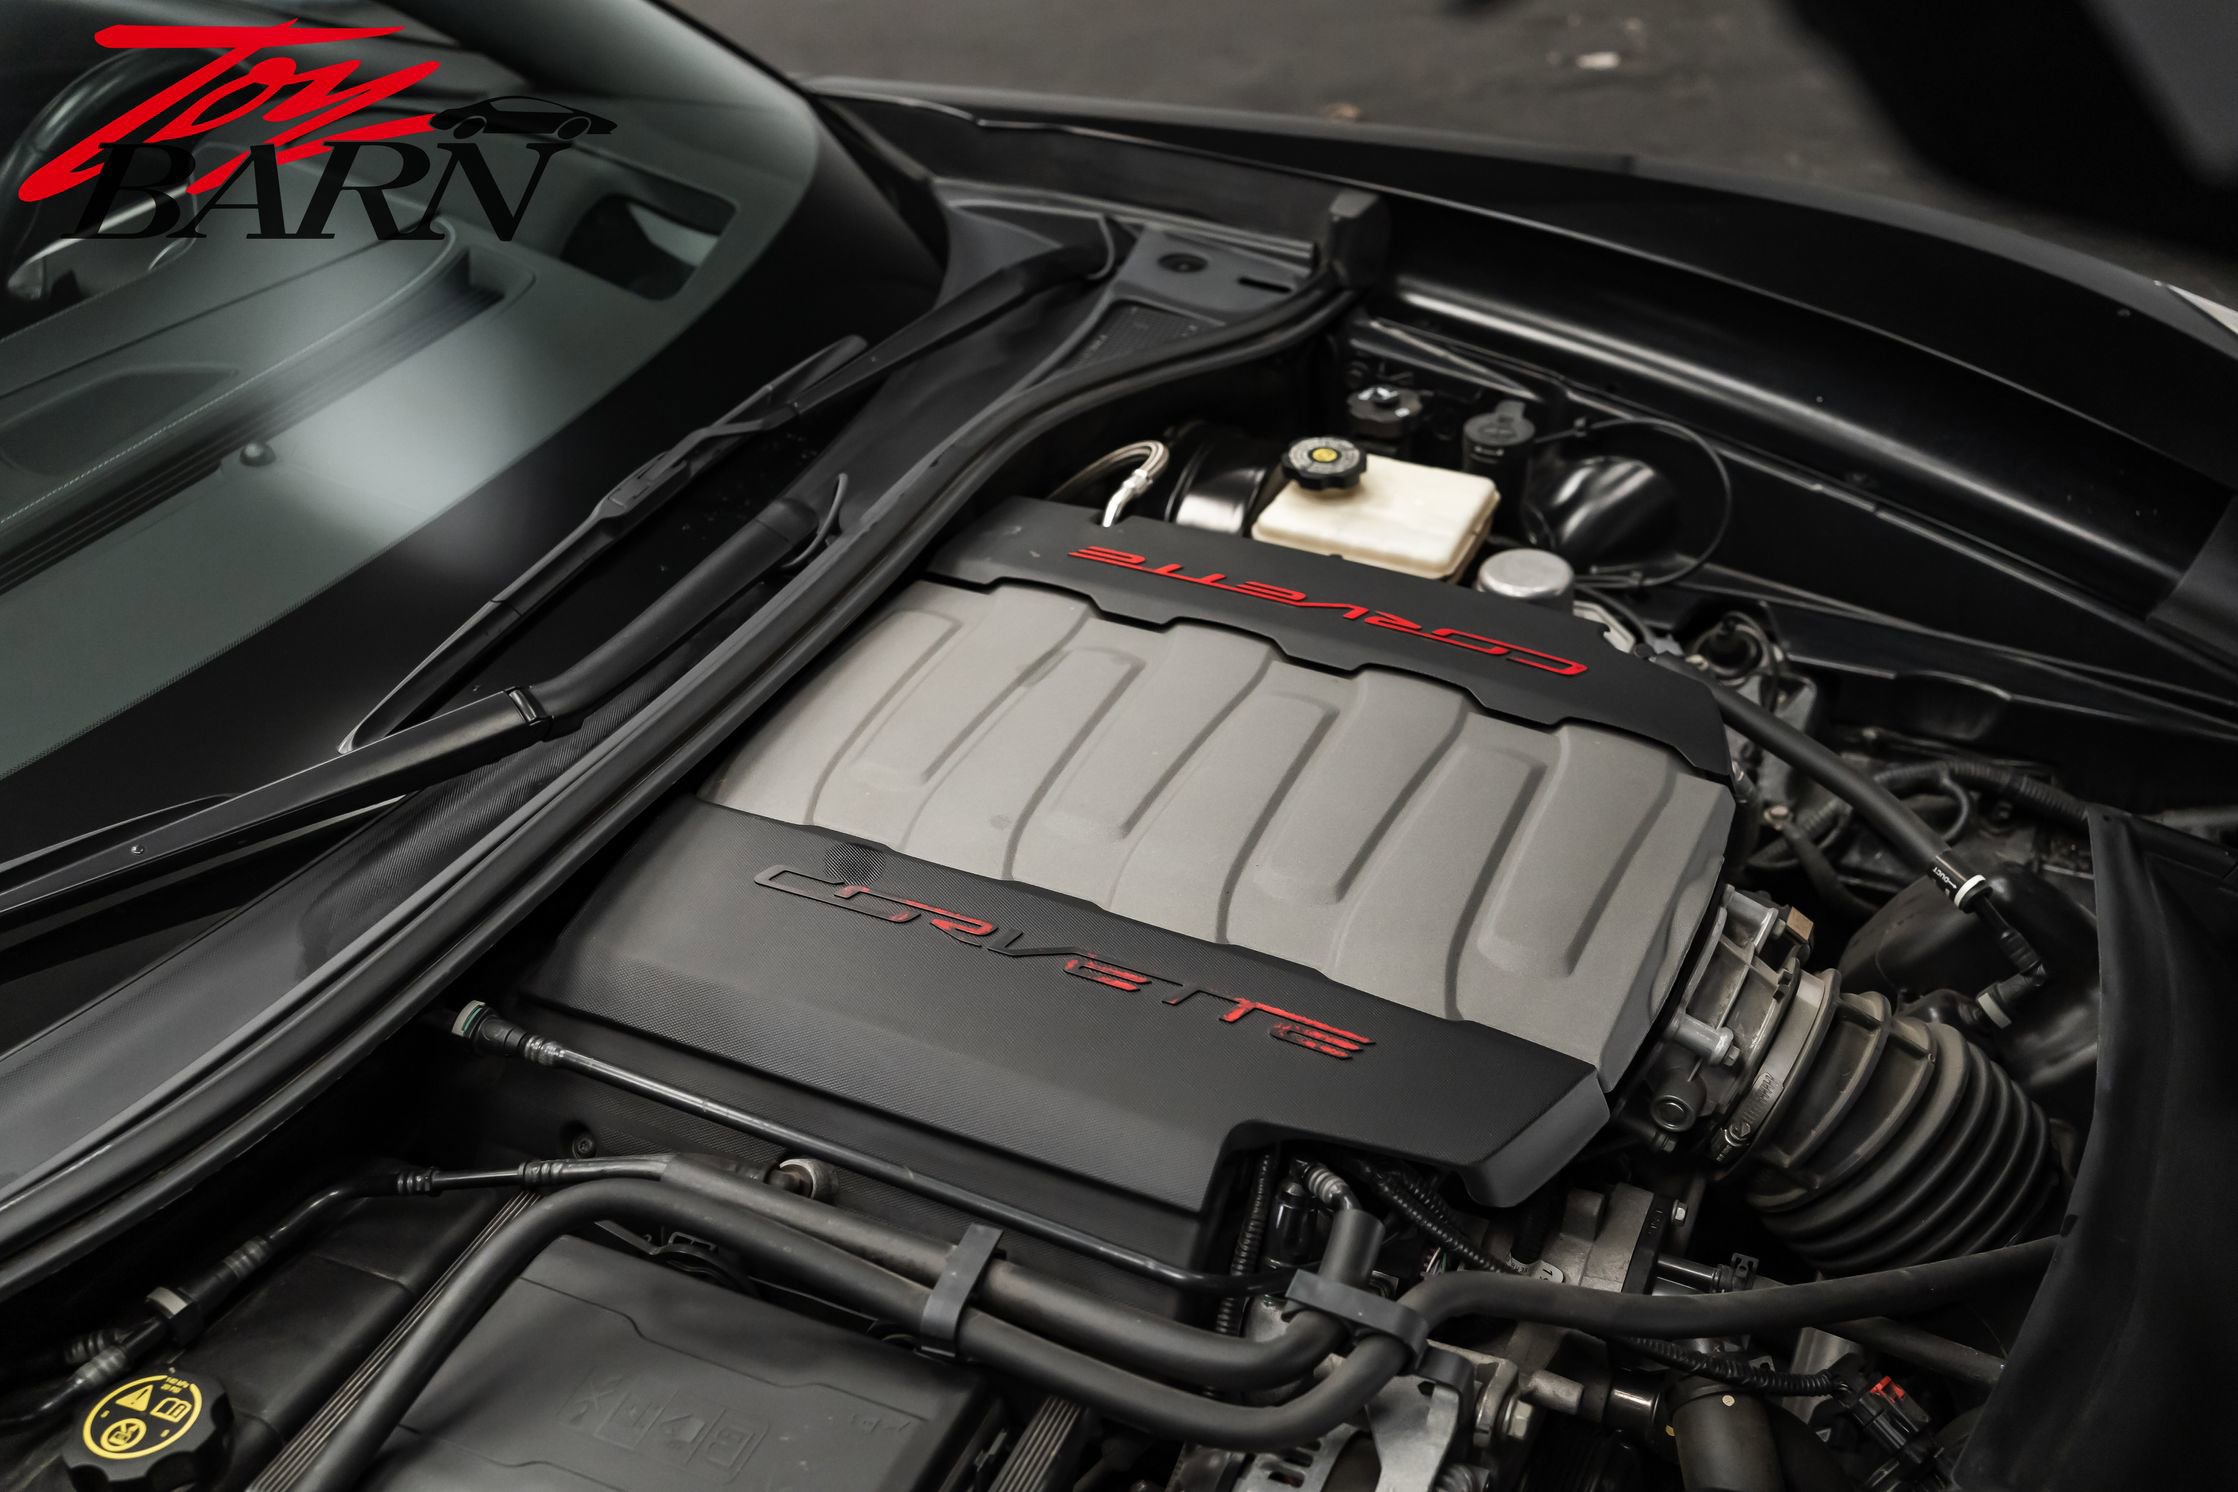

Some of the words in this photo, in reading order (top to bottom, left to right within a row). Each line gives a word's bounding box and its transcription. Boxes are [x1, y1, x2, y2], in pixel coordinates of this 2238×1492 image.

[1068, 545, 1588, 676] CORVETTE
[1932, 866, 1950, 884] DUCT
[753, 864, 1375, 1062] CORVETTE
